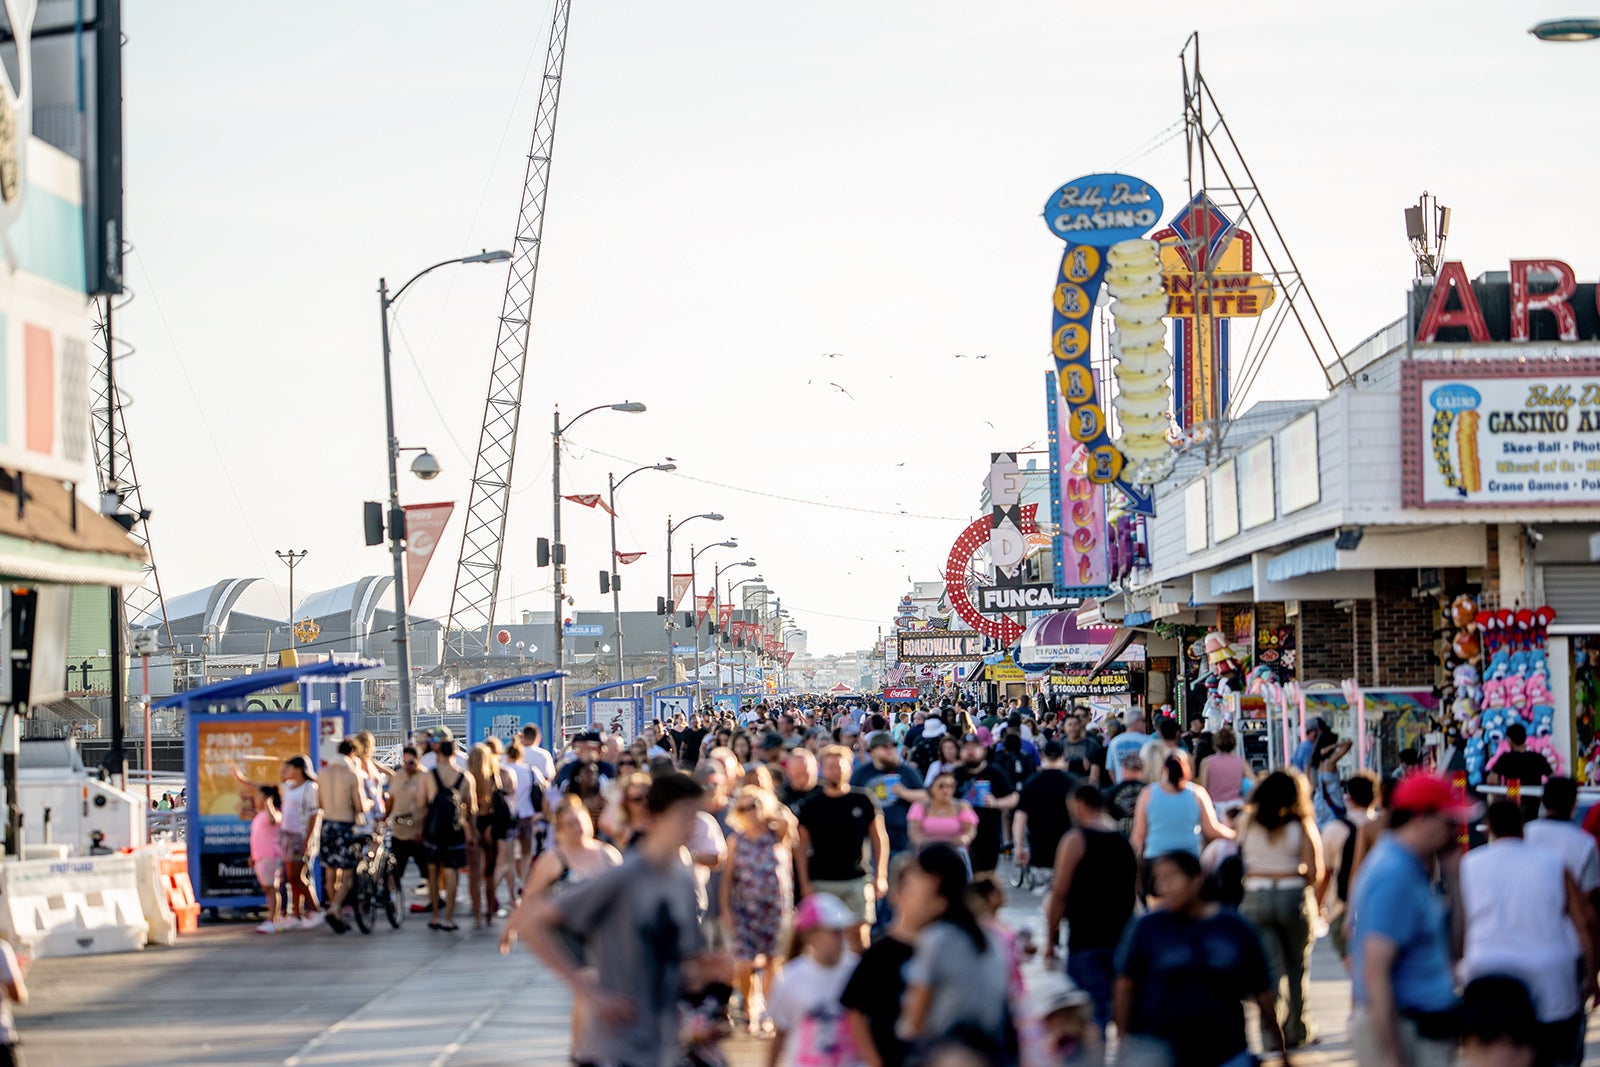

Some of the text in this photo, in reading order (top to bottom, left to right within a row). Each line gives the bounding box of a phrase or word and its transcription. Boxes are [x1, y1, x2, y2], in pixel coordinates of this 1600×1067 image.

[1054, 208, 1156, 232] CASINO
[1167, 295, 1257, 314] HITE
[1417, 259, 1600, 343] AR
[1488, 411, 1568, 434] CASINO
[1502, 440, 1561, 454] Skee-Ball
[1489, 479, 1523, 492] Crane
[1528, 479, 1569, 491] Games
[903, 638, 962, 656] BOARDWALK
[1053, 684, 1126, 695] $1000.00 1st place
